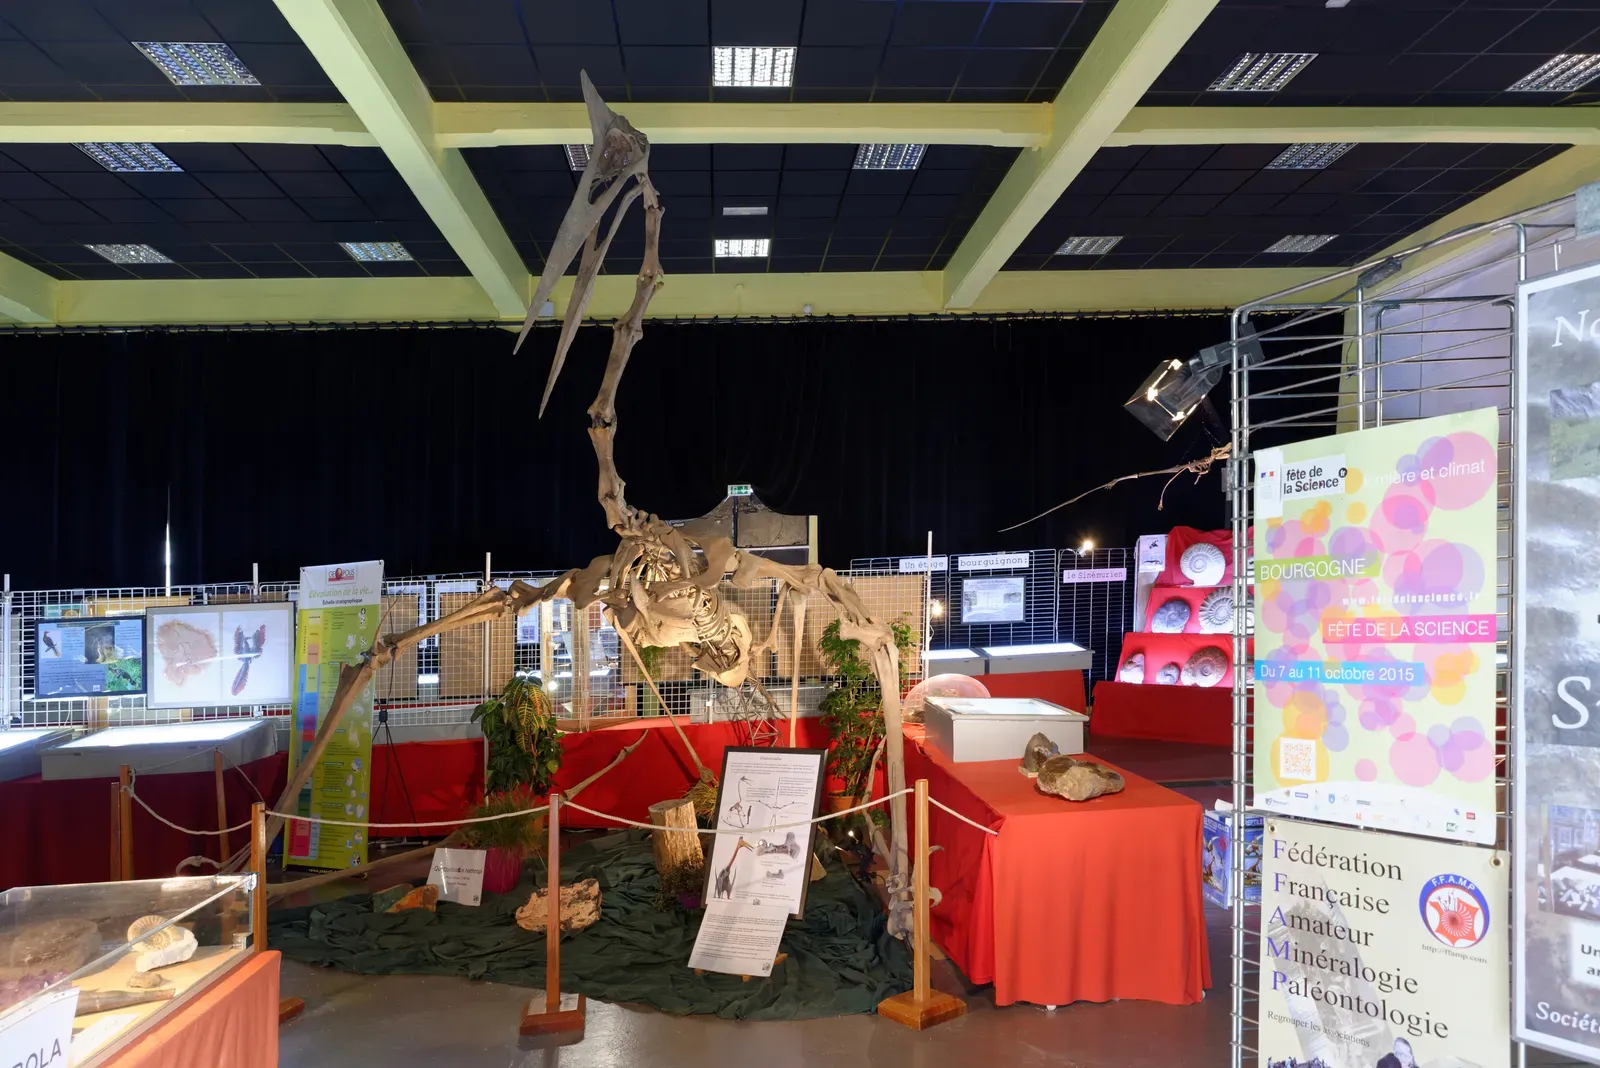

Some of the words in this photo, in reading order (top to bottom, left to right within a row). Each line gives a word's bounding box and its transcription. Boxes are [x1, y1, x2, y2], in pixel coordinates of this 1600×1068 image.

[1283, 483, 1293, 494] la
[1295, 478, 1339, 492] Science
[1286, 469, 1306, 481] fête
[1309, 465, 1323, 478] de
[1420, 466, 1435, 480] et
[1439, 459, 1485, 478] climat
[1067, 571, 1076, 579] le
[1260, 558, 1366, 580] BOURGOGNE
[1328, 620, 1361, 637] FÊTE
[1366, 622, 1386, 637] DE
[1390, 621, 1410, 637] LA
[1414, 620, 1489, 636] SCIENCE
[1260, 664, 1276, 678] Du
[1278, 665, 1286, 678] 7
[1289, 667, 1303, 679] au
[1308, 667, 1321, 679] 11
[1325, 667, 1375, 681] octobre
[1379, 667, 1415, 682] 2015
[1552, 676, 1600, 729] S
[1272, 838, 1404, 881] Fédération
[1273, 872, 1390, 915] Française
[1268, 905, 1374, 947] Amateur
[1265, 936, 1419, 994] Minéralogie
[1272, 969, 1449, 1039] Paléontologie
[1536, 1001, 1600, 1034] Sociét
[1267, 1010, 1308, 1029] Regrouper
[1310, 1021, 1321, 1032] les
[1322, 1026, 1371, 1048] associations
